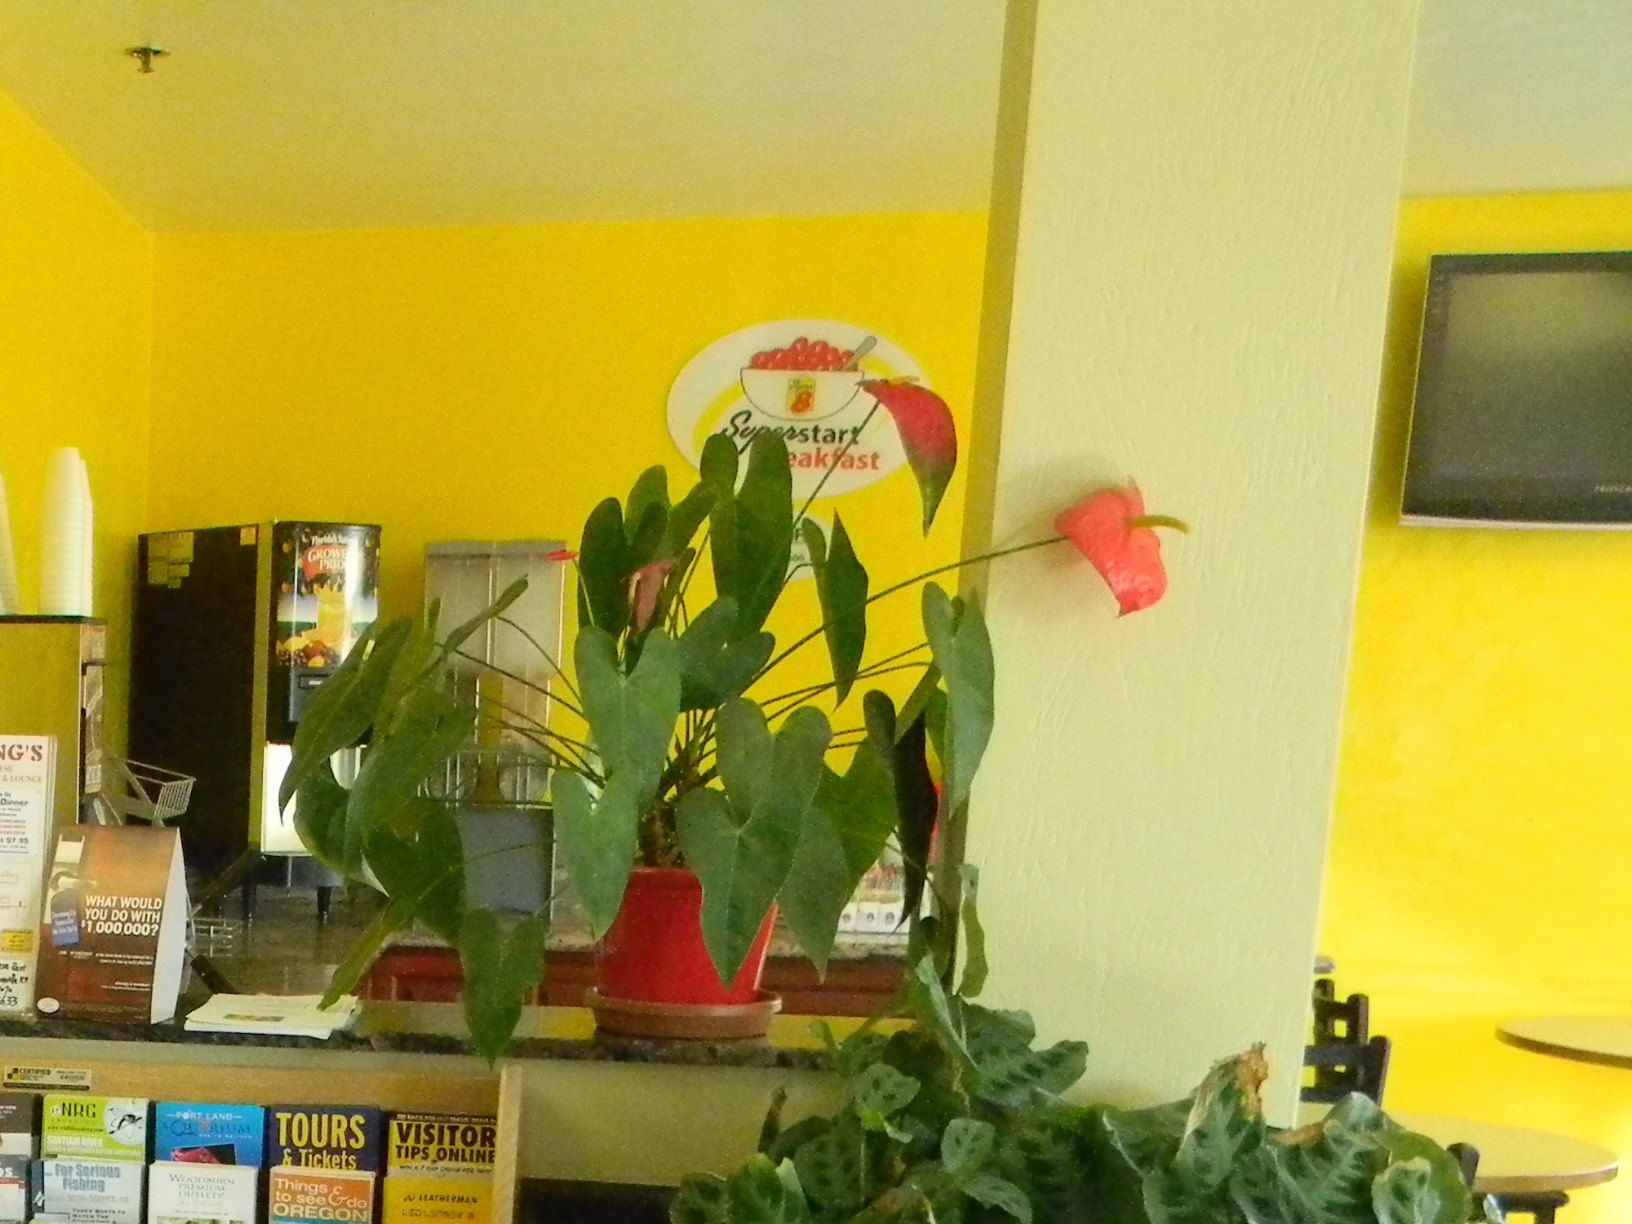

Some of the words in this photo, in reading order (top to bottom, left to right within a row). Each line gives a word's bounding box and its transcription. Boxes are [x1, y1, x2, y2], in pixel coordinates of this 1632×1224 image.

[720, 410, 858, 455] Superstart
[789, 448, 880, 470] eakfast
[0, 798, 29, 806] Dinner
[86, 895, 119, 907] WHAT
[121, 896, 163, 909] WOULD
[85, 907, 107, 920] YOU
[111, 909, 128, 922] DO
[130, 910, 161, 923] WITH
[276, 1112, 366, 1150] TOURS
[396, 1122, 496, 1147] VISITOR
[282, 1149, 292, 1165] &
[299, 1150, 357, 1170] Tickets
[395, 1145, 430, 1161] TIPS
[435, 1148, 495, 1164] ONLINE
[55, 1163, 75, 1176] For
[77, 1164, 122, 1178] Serious
[62, 1177, 106, 1192] Fishing
[274, 1178, 329, 1193] Things
[273, 1203, 367, 1222] OREGON
